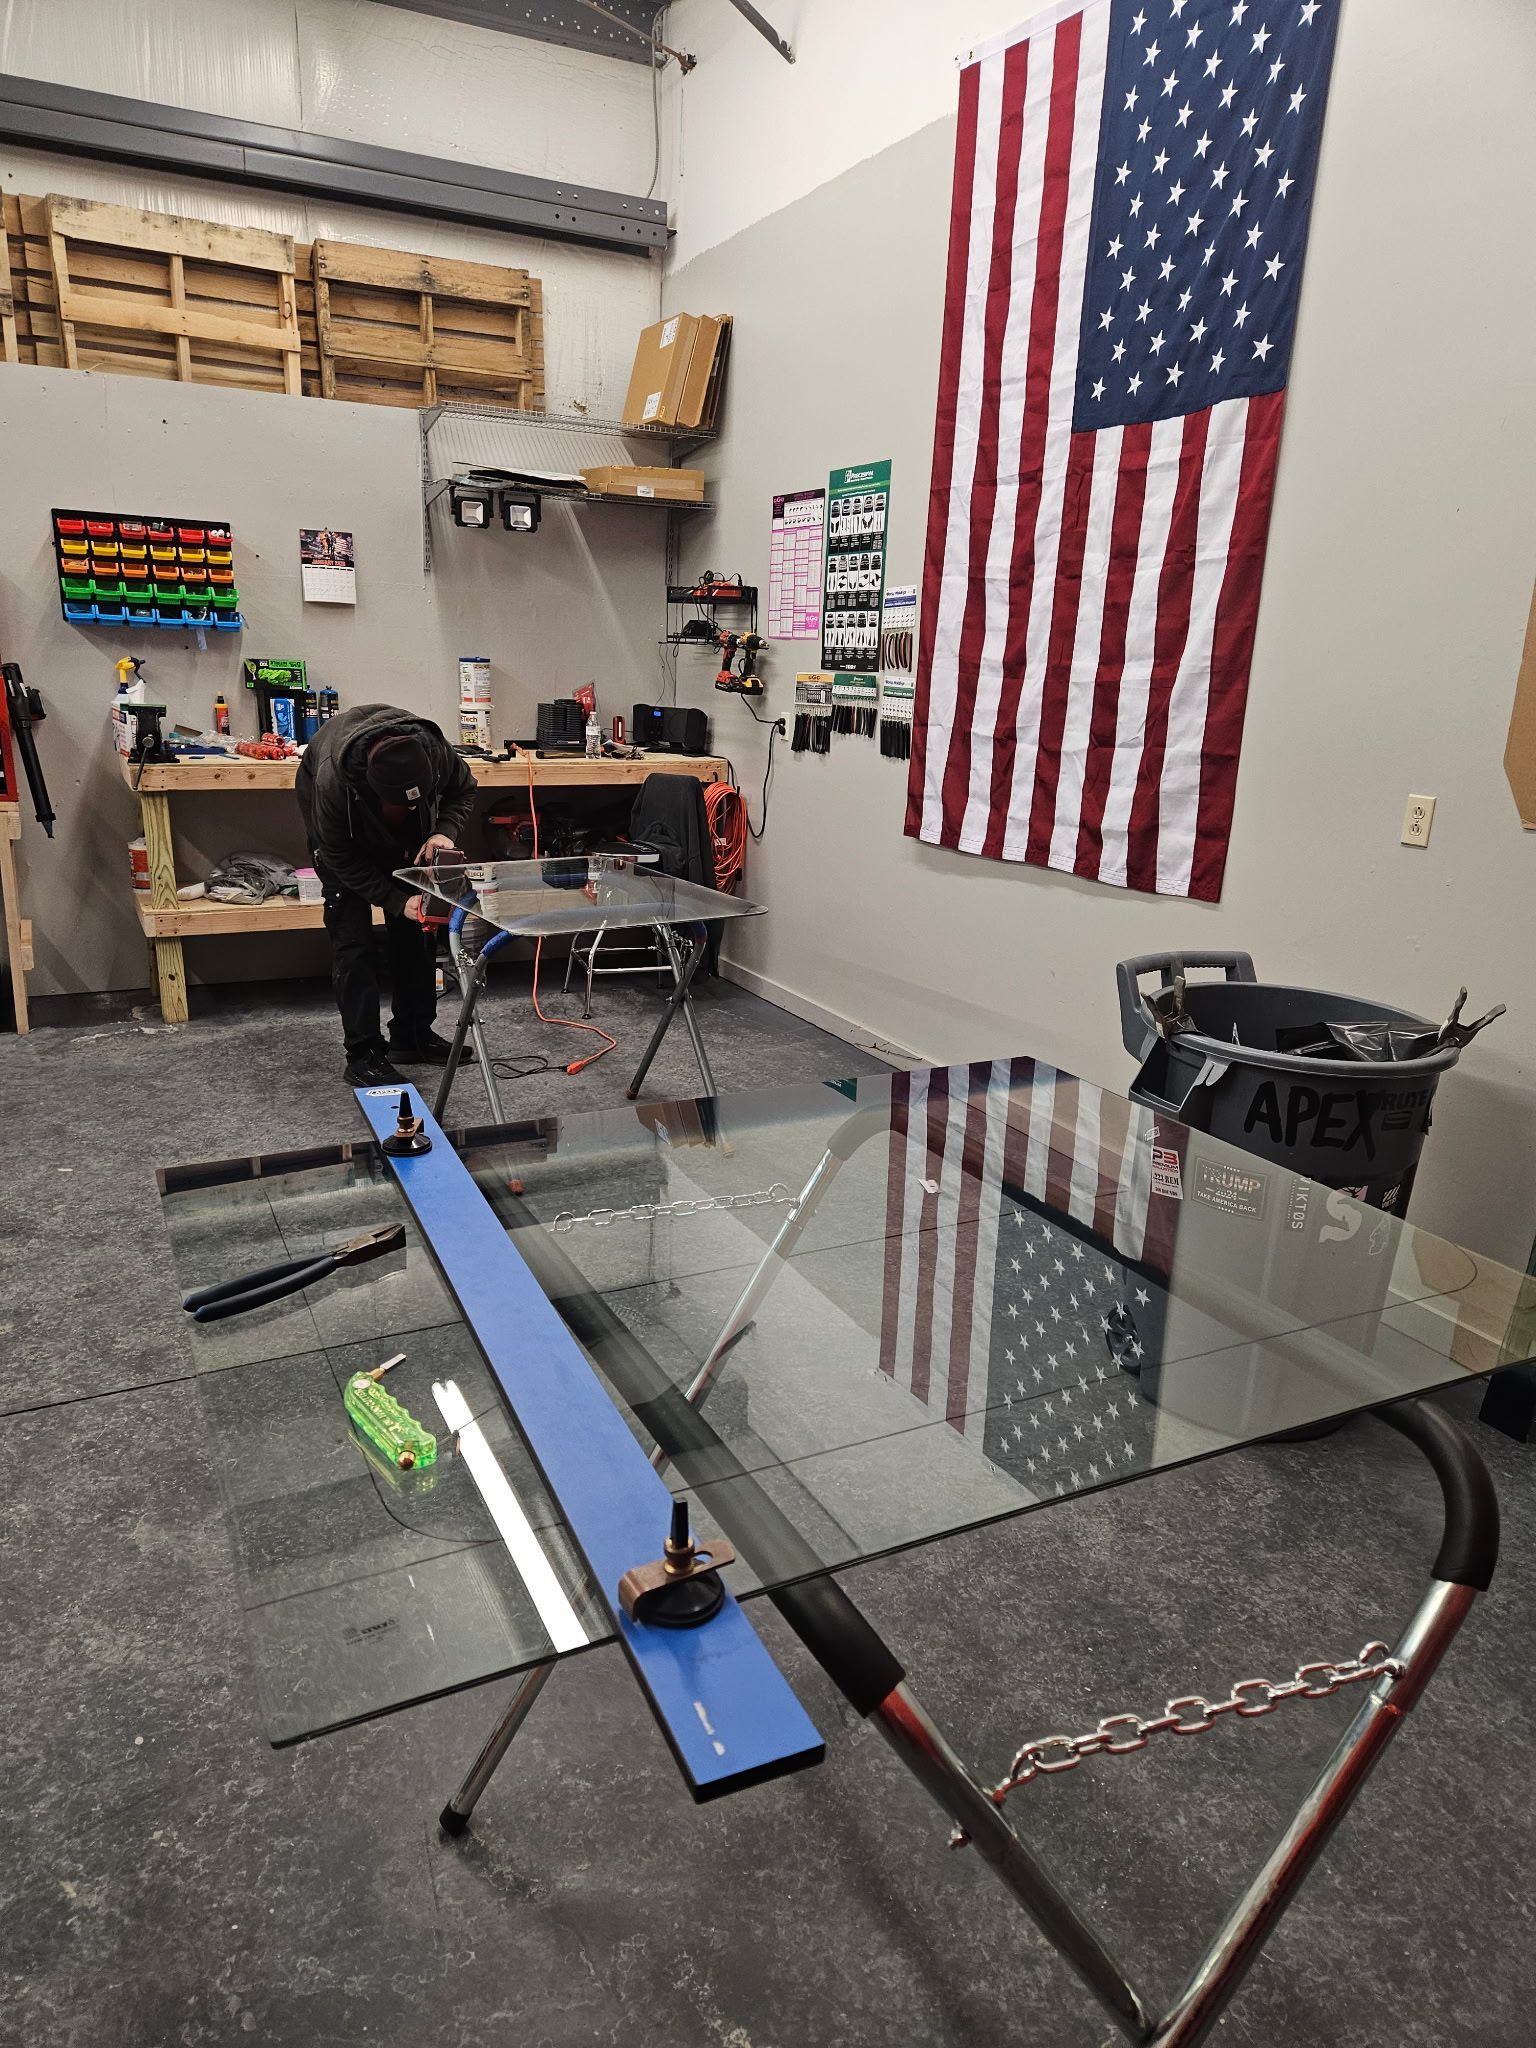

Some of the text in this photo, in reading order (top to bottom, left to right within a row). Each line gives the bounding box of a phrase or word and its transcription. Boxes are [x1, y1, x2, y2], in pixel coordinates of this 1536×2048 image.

[1368, 1088, 1429, 1112] RUTE
[1243, 1080, 1377, 1163] APEX
[1152, 1148, 1178, 1165] P3
[1202, 1164, 1261, 1194] TRUMP
[1197, 1190, 1257, 1213] TAKE AMERICA BACK
